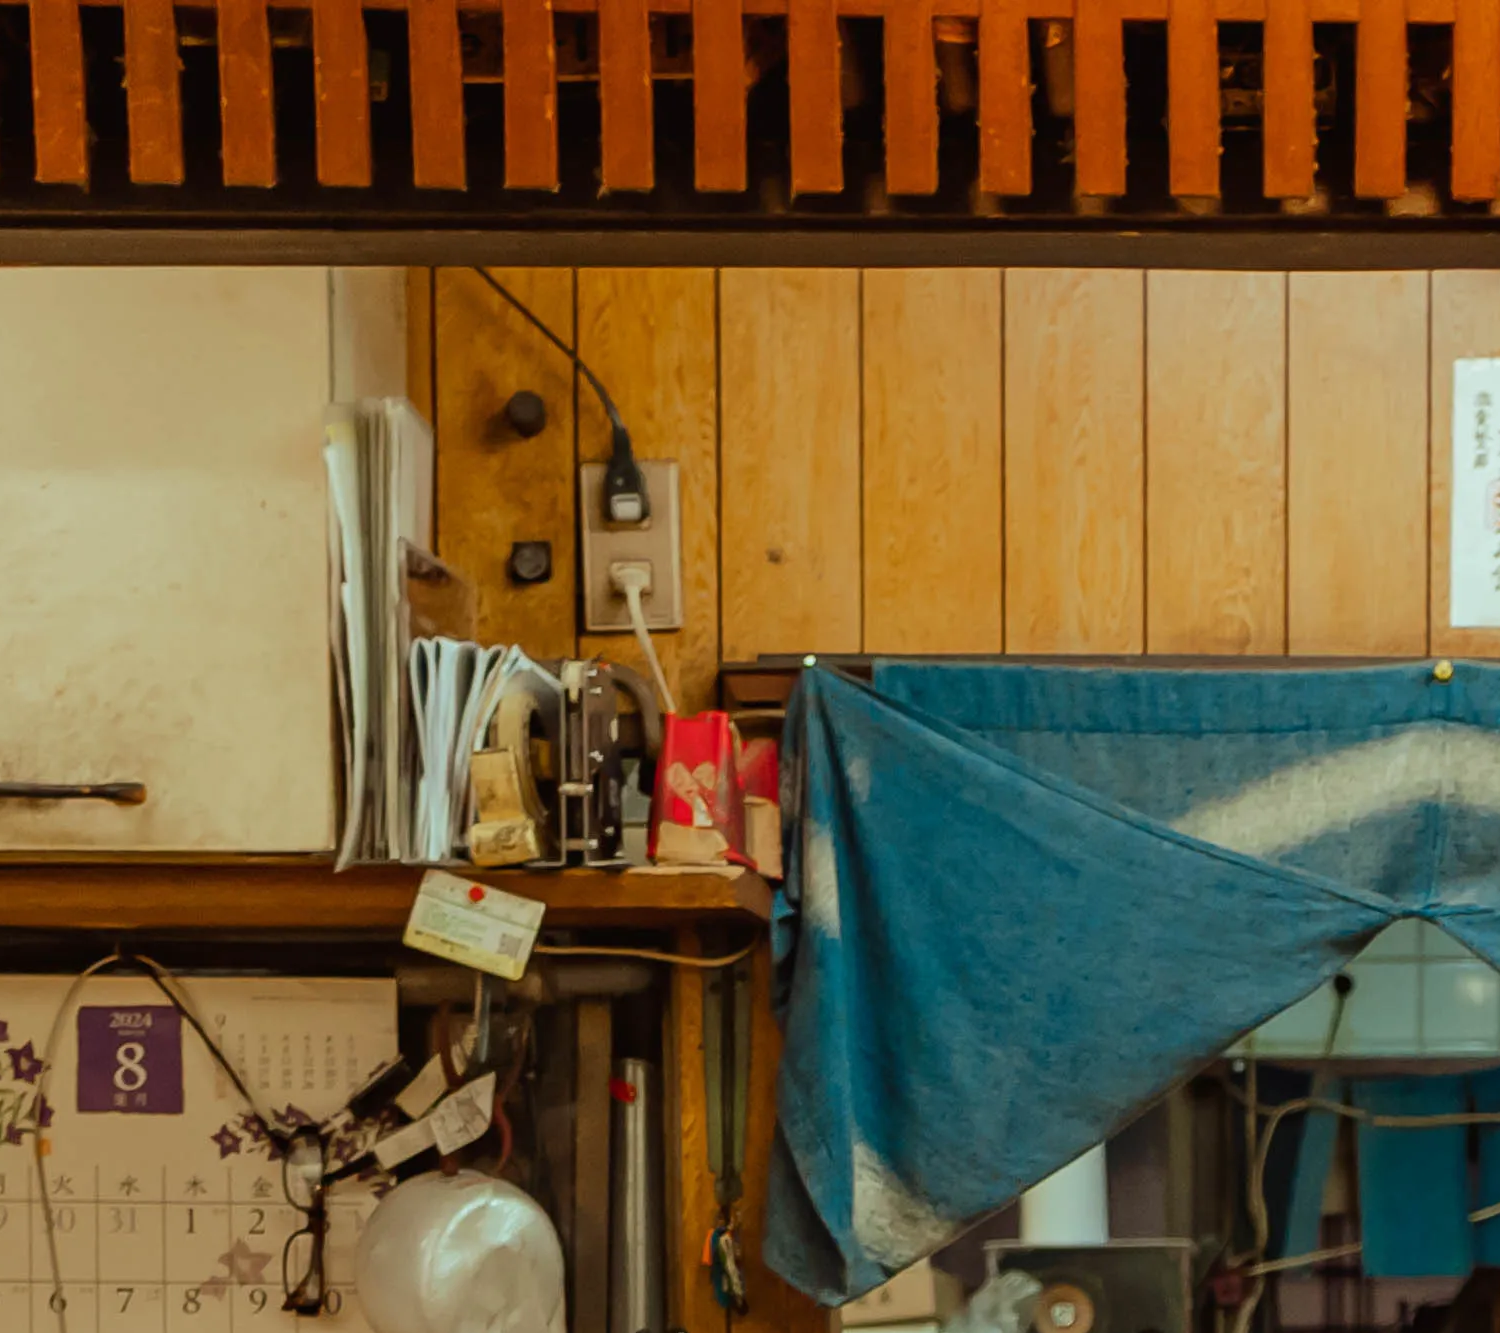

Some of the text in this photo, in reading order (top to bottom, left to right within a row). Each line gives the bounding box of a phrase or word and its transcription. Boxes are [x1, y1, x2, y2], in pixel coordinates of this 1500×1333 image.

[109, 1012, 153, 1028] 2024
[113, 1042, 147, 1091] 8
[53, 1176, 74, 1195] 火
[120, 1175, 140, 1196] 水
[184, 1176, 207, 1196] 木
[252, 1176, 274, 1198] 金
[108, 1207, 138, 1233] 31
[186, 1208, 196, 1234] 1
[249, 1208, 265, 1235] 2
[49, 1286, 67, 1314] 6
[116, 1288, 135, 1313] 7
[182, 1288, 201, 1314] 8
[249, 1288, 267, 1314] 9
